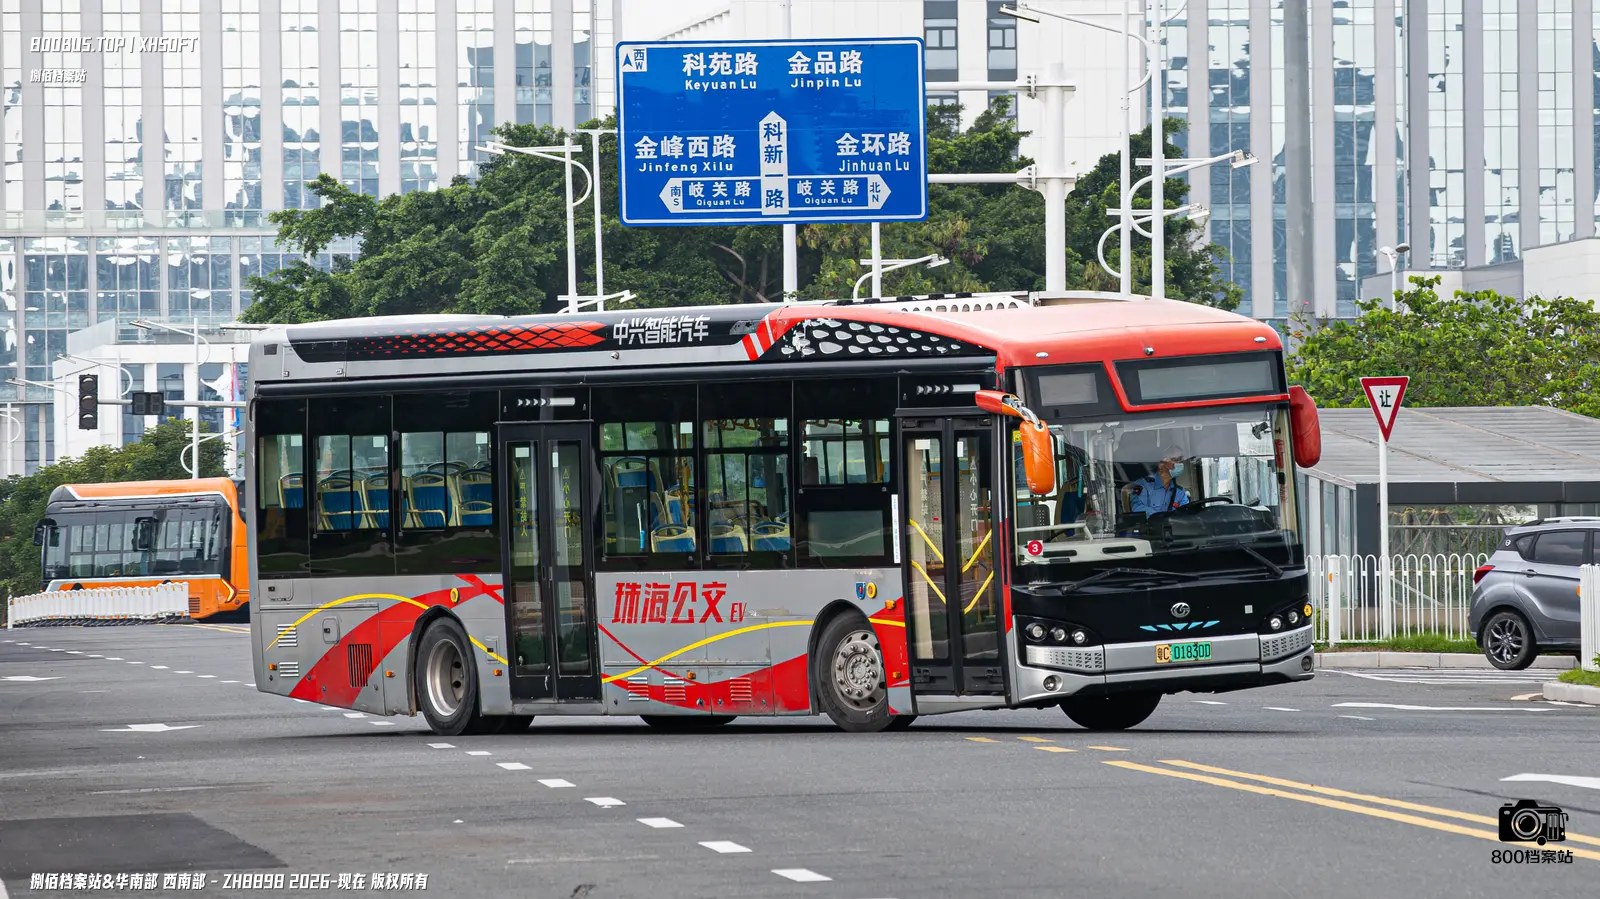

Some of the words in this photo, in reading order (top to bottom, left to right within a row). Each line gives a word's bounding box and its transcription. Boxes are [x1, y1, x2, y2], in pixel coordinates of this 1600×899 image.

[633, 49, 645, 61] 西
[787, 50, 863, 75] 金品路
[635, 61, 643, 70] W
[682, 51, 759, 76] 科苑路
[685, 79, 737, 92] Keyuan
[741, 79, 757, 90] Lu
[790, 78, 839, 90] Jinpin
[844, 77, 862, 87] Lu
[634, 134, 736, 159] 金峰西路
[835, 132, 912, 157] 金环路
[638, 162, 697, 174] Jinfeng
[702, 161, 733, 172] Xilu
[763, 122, 785, 209] 科新一路
[839, 160, 891, 172] Jinhuan
[895, 159, 910, 171] Lu
[670, 185, 681, 197] 南
[688, 181, 751, 198] 岐关路
[796, 179, 859, 196] 岐关路
[869, 182, 881, 194] 北
[673, 198, 680, 206] S
[872, 194, 879, 203] N
[612, 315, 710, 345] 中兴智能汽车
[1379, 390, 1391, 407] 让
[611, 581, 727, 624] 珠海公交
[729, 602, 747, 622] EV
